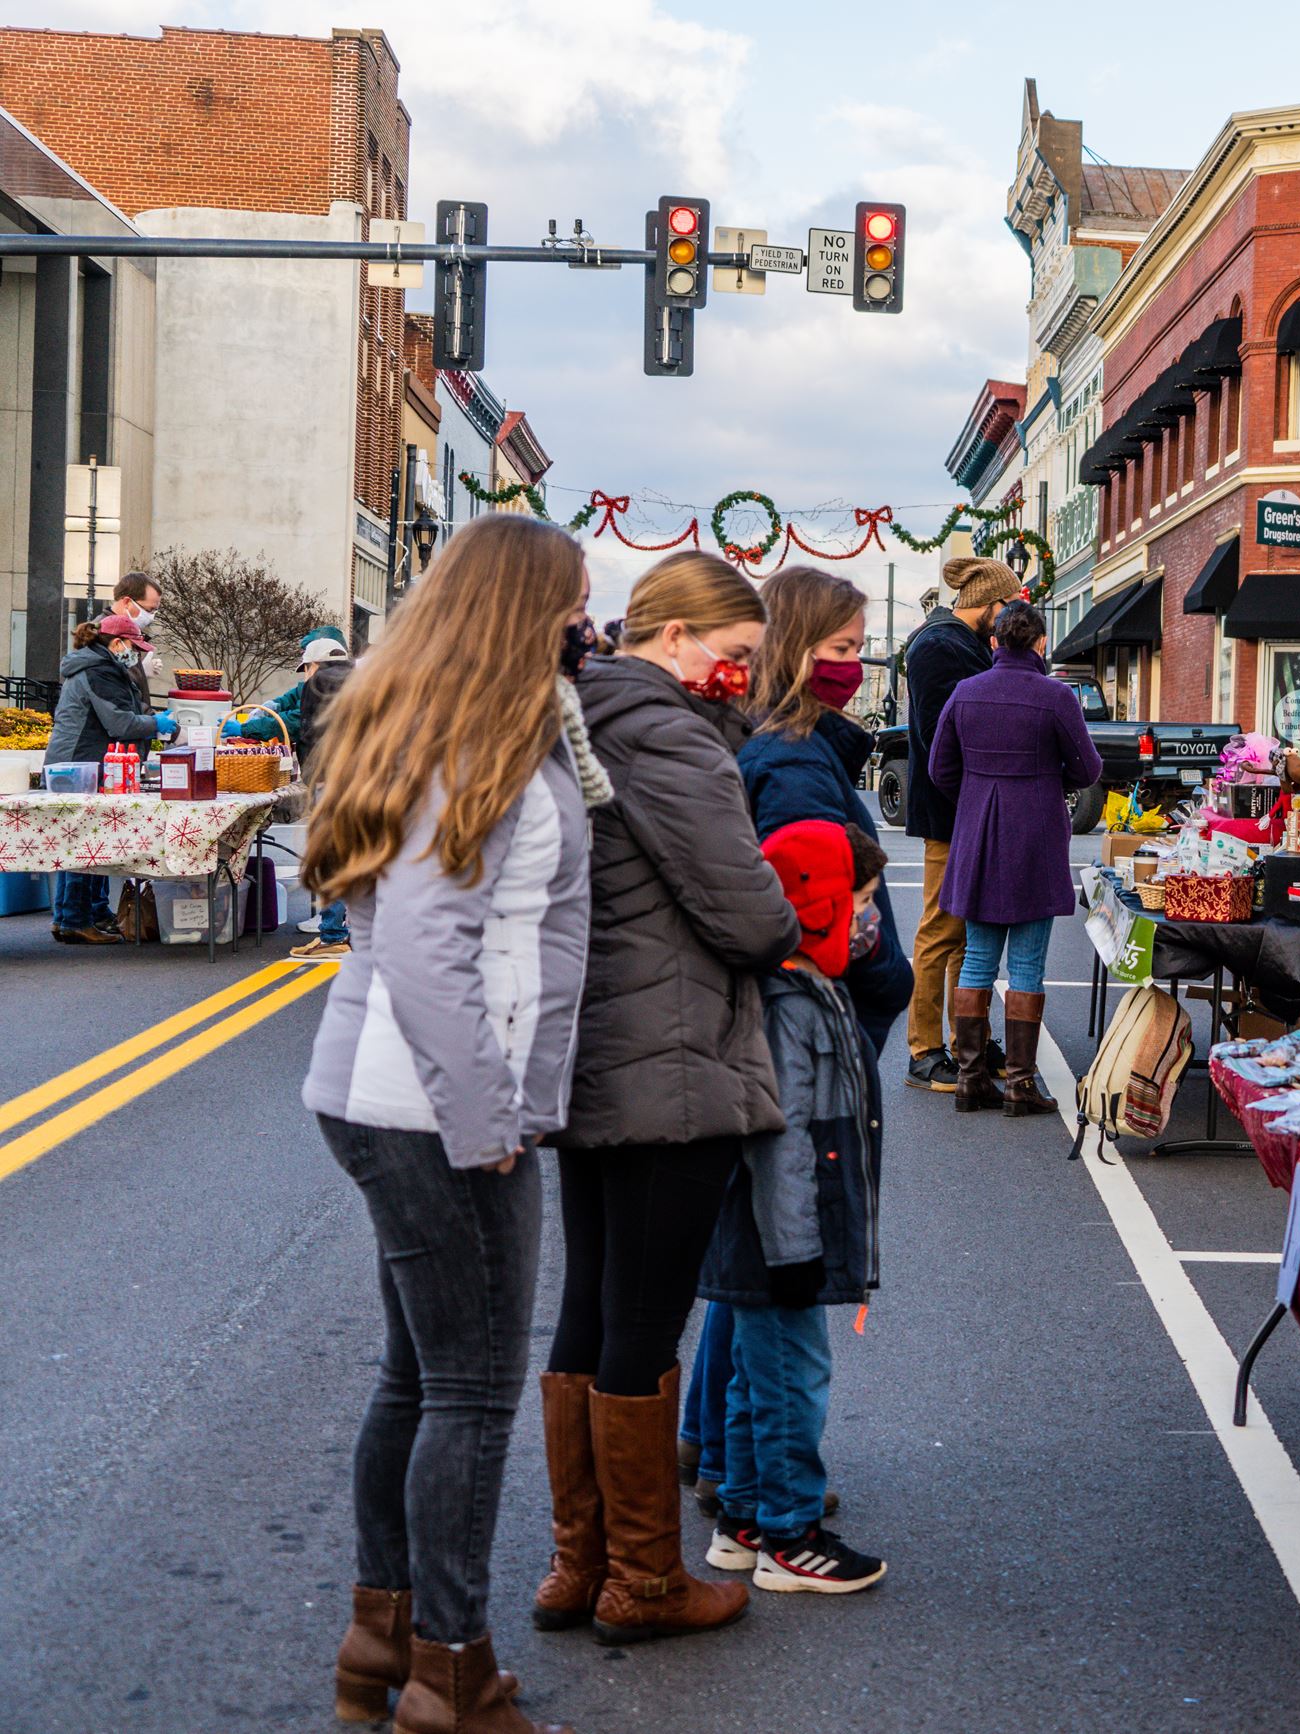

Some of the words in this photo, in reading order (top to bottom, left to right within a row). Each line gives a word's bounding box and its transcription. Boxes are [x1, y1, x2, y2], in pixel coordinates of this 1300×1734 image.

[824, 235, 846, 249] NO
[760, 248, 782, 259] YIELD
[785, 251, 794, 260] TO
[819, 250, 849, 262] TURN
[754, 258, 798, 270] PEDESTRIAN
[825, 264, 841, 276] ON
[822, 278, 844, 289] RED
[1264, 506, 1300, 527] Green's
[1263, 527, 1300, 543] Drugstore
[1174, 743, 1218, 755] TOYOTA
